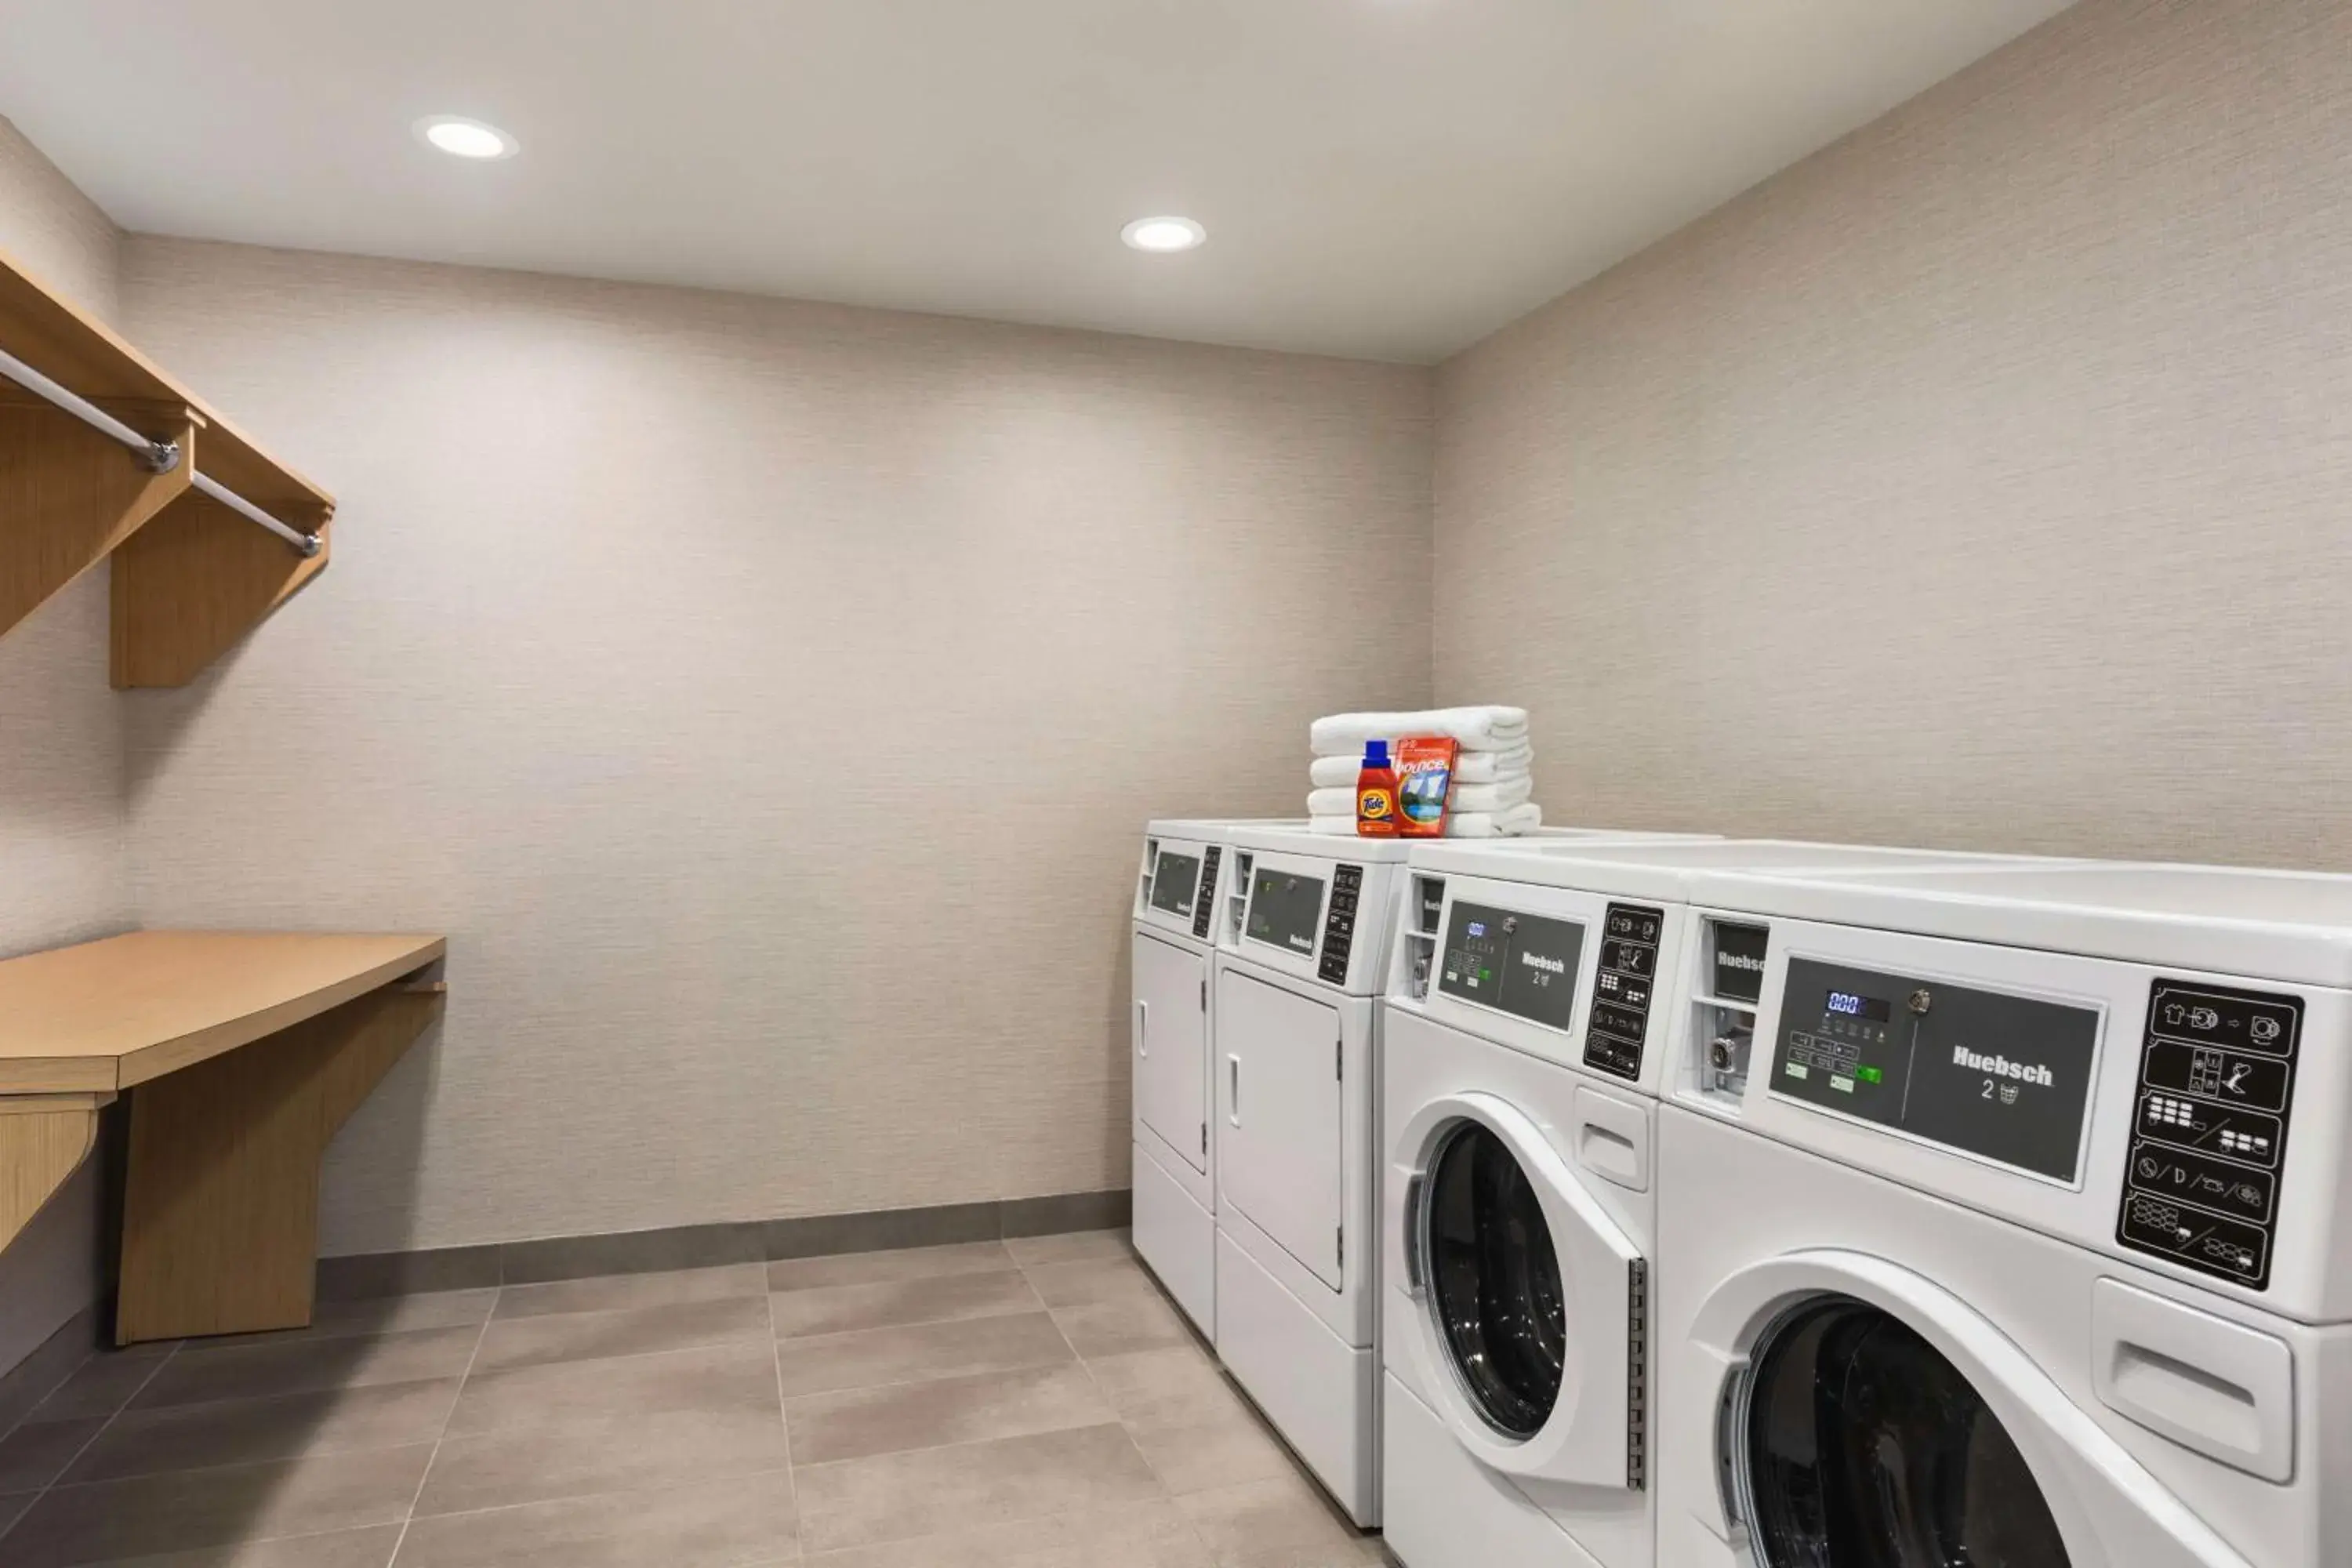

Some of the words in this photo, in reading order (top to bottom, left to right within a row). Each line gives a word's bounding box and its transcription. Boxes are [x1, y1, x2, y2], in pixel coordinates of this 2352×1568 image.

[1523, 951, 1565, 975] Huebsch
[1719, 951, 1766, 972] Huebsc
[1953, 1045, 2053, 1086] Huebsch
[1981, 1079, 1994, 1098] 2
[2174, 1167, 2186, 1183] D
